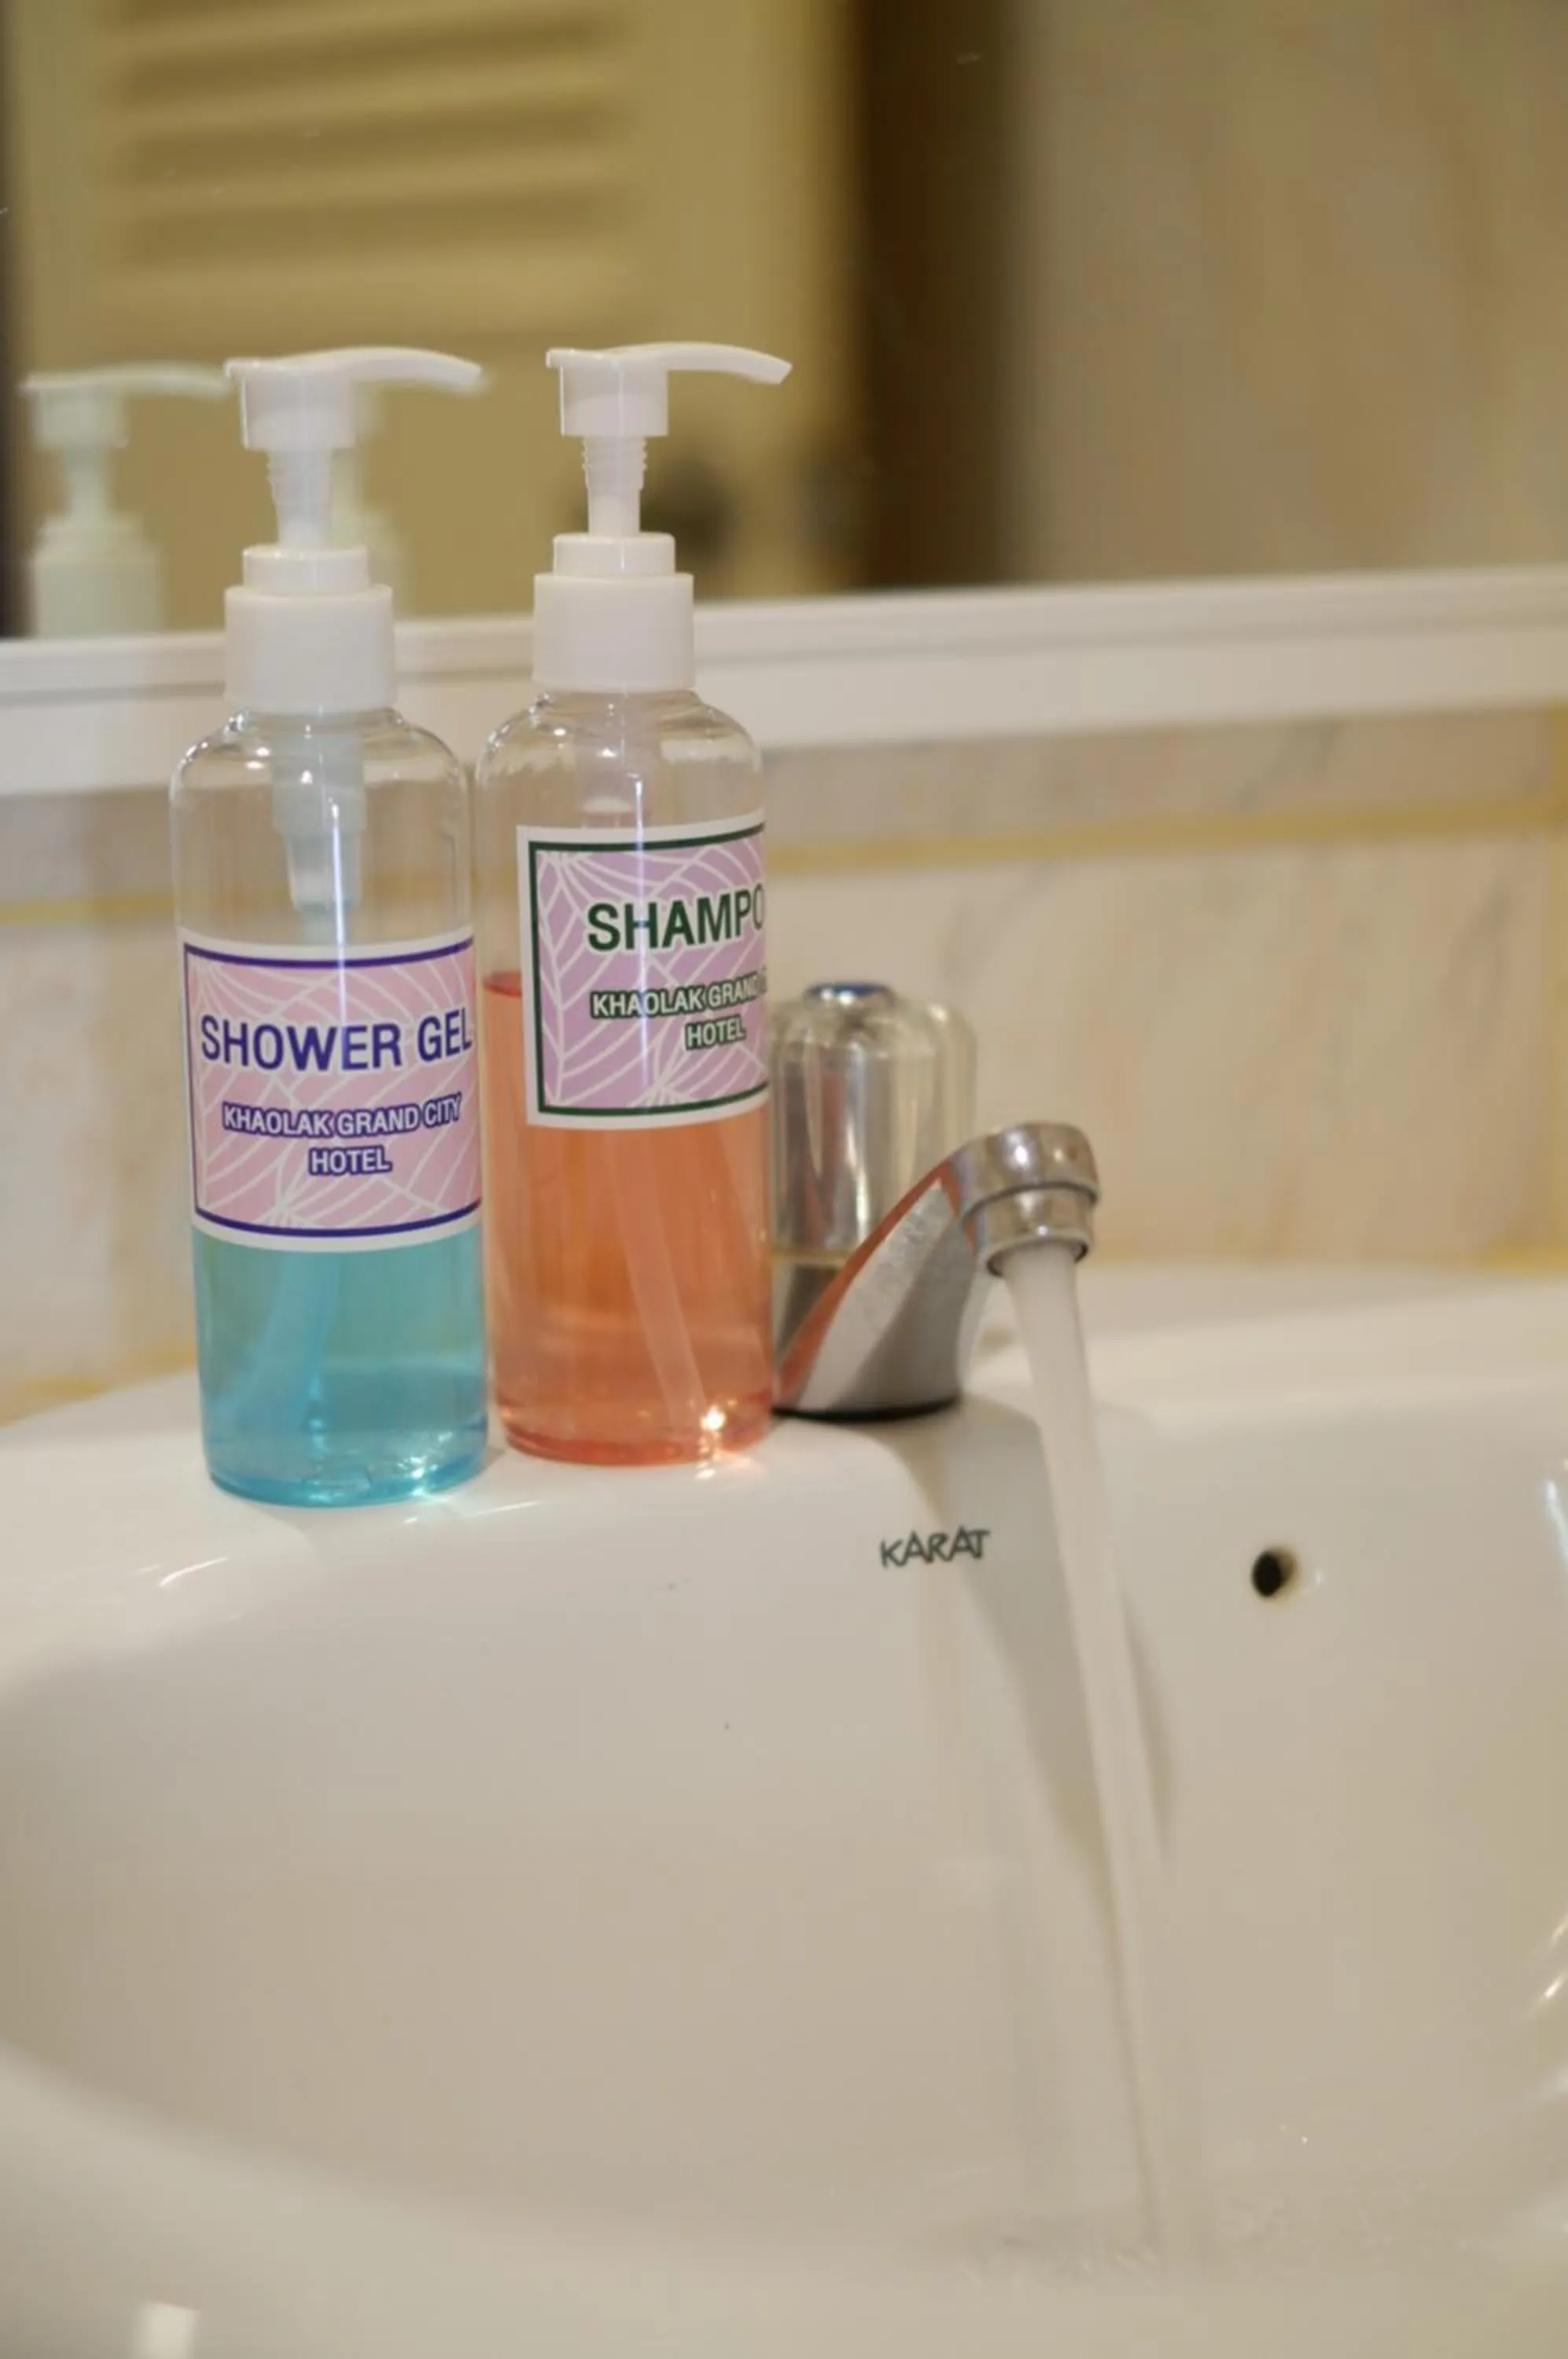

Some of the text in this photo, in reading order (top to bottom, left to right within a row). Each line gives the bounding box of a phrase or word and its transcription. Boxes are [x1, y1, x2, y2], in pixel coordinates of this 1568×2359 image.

[590, 984, 705, 1019] KHAOLAK
[201, 1007, 473, 1071] SHOWER GEL
[685, 1014, 746, 1051] HOTEL
[222, 1092, 462, 1139] KHAOLAK GRAND CITY
[308, 1145, 392, 1176] HOTEL
[880, 1525, 991, 1568] KARAT
